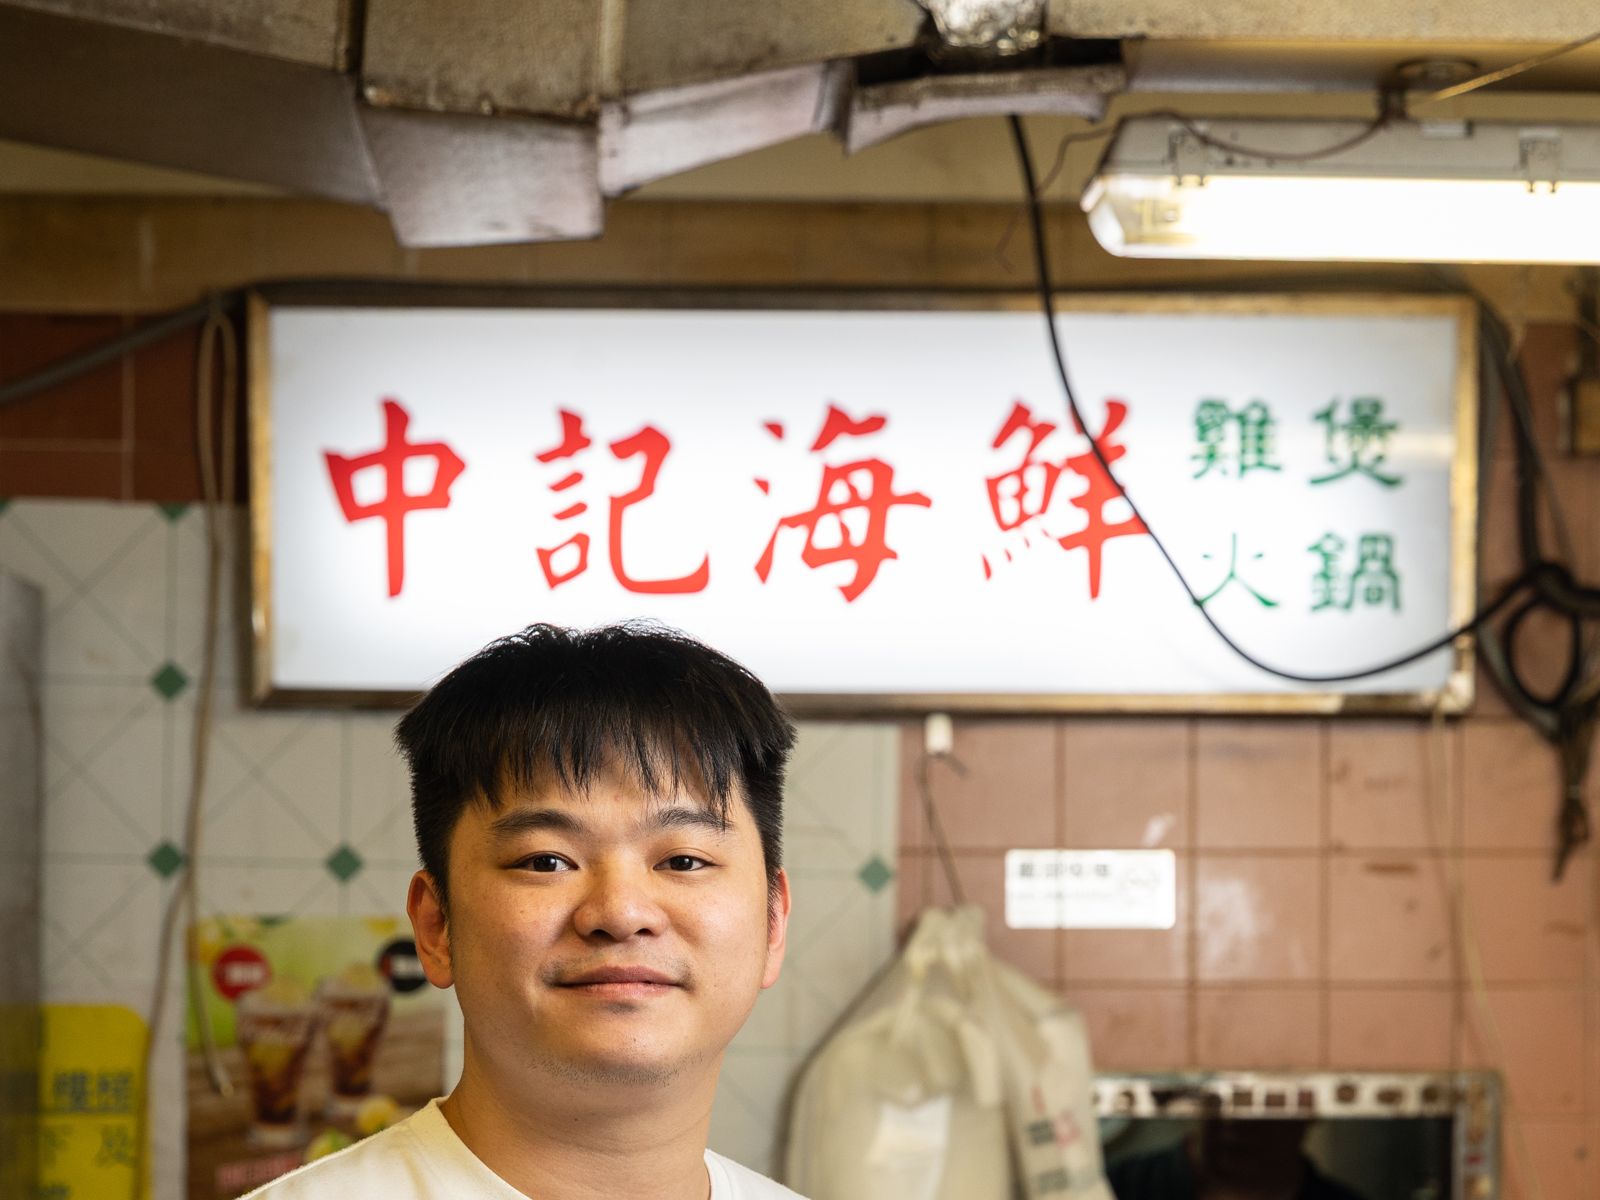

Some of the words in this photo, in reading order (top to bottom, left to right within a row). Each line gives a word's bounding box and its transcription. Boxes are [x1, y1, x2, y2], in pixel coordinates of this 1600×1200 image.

[1190, 396, 1405, 487] 雞煲
[322, 399, 1150, 605] 中記海鮮
[1195, 531, 1402, 613] 火鍋
